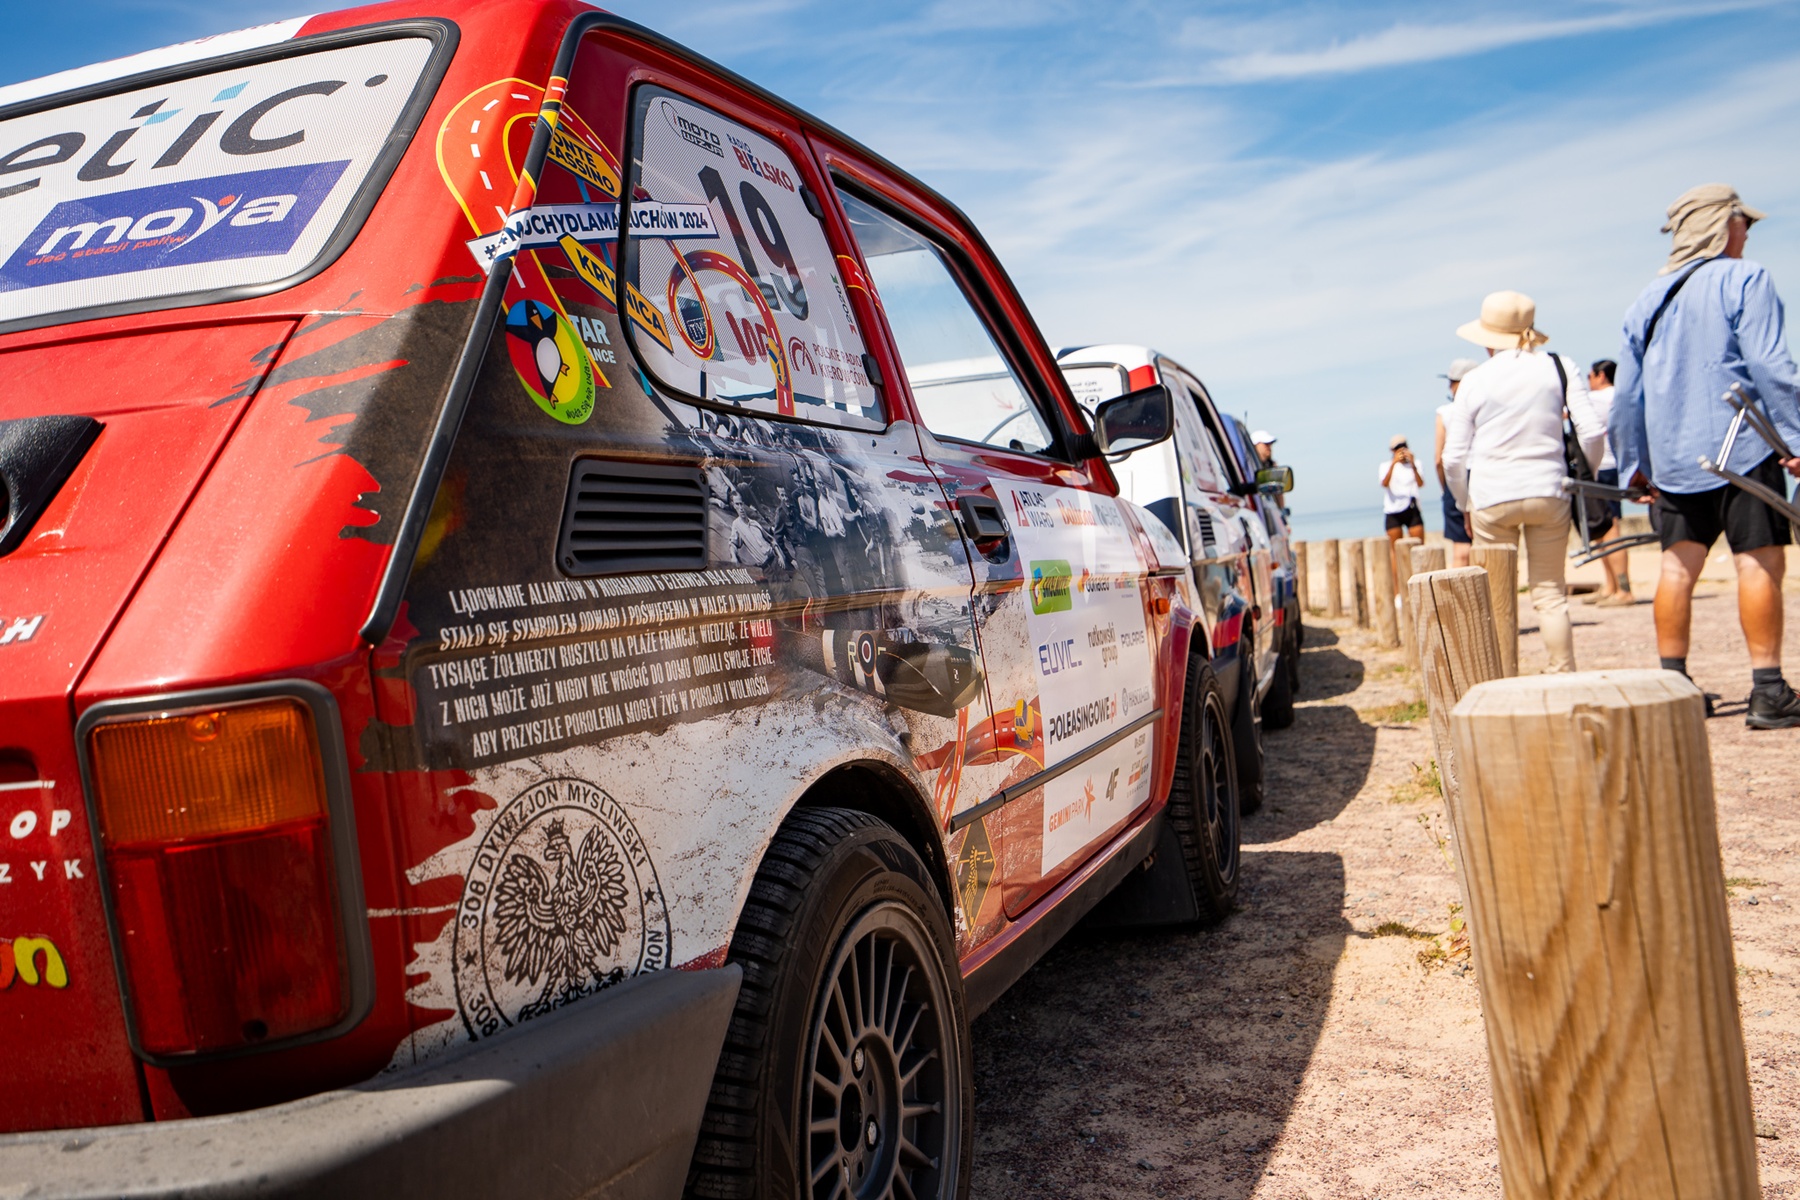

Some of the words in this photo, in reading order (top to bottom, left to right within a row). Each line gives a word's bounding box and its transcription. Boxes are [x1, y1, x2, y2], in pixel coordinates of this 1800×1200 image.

[552, 131, 598, 169] ONTE
[677, 116, 721, 147] MOTO
[549, 147, 616, 193] ASSINO
[732, 145, 795, 193] BIELSKO
[36, 193, 298, 253] moya
[680, 211, 709, 229] 2024
[697, 165, 809, 321] 19
[568, 314, 611, 346] TAR
[812, 343, 841, 362] POLSKIE
[1018, 490, 1047, 509] ATLAS
[1026, 510, 1055, 528] WARD
[448, 584, 528, 619] LĄDOWANIE
[528, 577, 588, 606] ALIANTÓW
[584, 579, 600, 599] W
[656, 573, 665, 592] 6
[661, 571, 709, 590] CZERWCA
[705, 569, 731, 587] 1944
[439, 623, 486, 652] STAŁO
[488, 620, 510, 648] SIĘ
[512, 612, 578, 642] SYMBOLEM
[579, 606, 620, 633] ODWAGI
[628, 598, 690, 627] POŚWIĘCENIA
[689, 597, 699, 617] W
[699, 594, 728, 616] WALCE
[728, 593, 736, 612] O
[735, 589, 772, 612] WOLNOŚĆ
[428, 656, 490, 690] TYSIĄCE
[490, 647, 557, 680] ŻOŁNIERZY
[559, 639, 609, 668] RUSZYŁO
[610, 636, 626, 659] NA
[627, 629, 658, 657] PLAŻE
[739, 617, 749, 640] ŻE
[749, 618, 773, 638] WIELU
[439, 701, 452, 727] Z
[454, 694, 489, 723] NICH
[490, 684, 527, 716] MOŻE
[530, 678, 554, 709] JUŻ
[555, 676, 589, 703] NIGDY
[591, 673, 610, 697] NIE
[610, 662, 650, 692] WRÓCIĆ
[650, 662, 665, 685] DO
[665, 657, 692, 682] DOMU
[693, 652, 723, 677] ODDALI
[724, 648, 751, 671] SWOJE
[472, 730, 498, 758] ABY
[501, 716, 564, 751] PRZYSZŁE
[564, 703, 624, 738] POKOLENIA
[624, 697, 658, 723] MOGŁY
[659, 688, 679, 716] ŻYĆ
[680, 691, 689, 712] W
[689, 682, 724, 709] POKOJU
[729, 673, 770, 700] WOLNOŚCI
[1049, 692, 1118, 746] POLEASINGOWE.pl
[1049, 810, 1071, 833] GEMINI
[461, 880, 487, 930] 308
[477, 784, 559, 874] DYWIZJON
